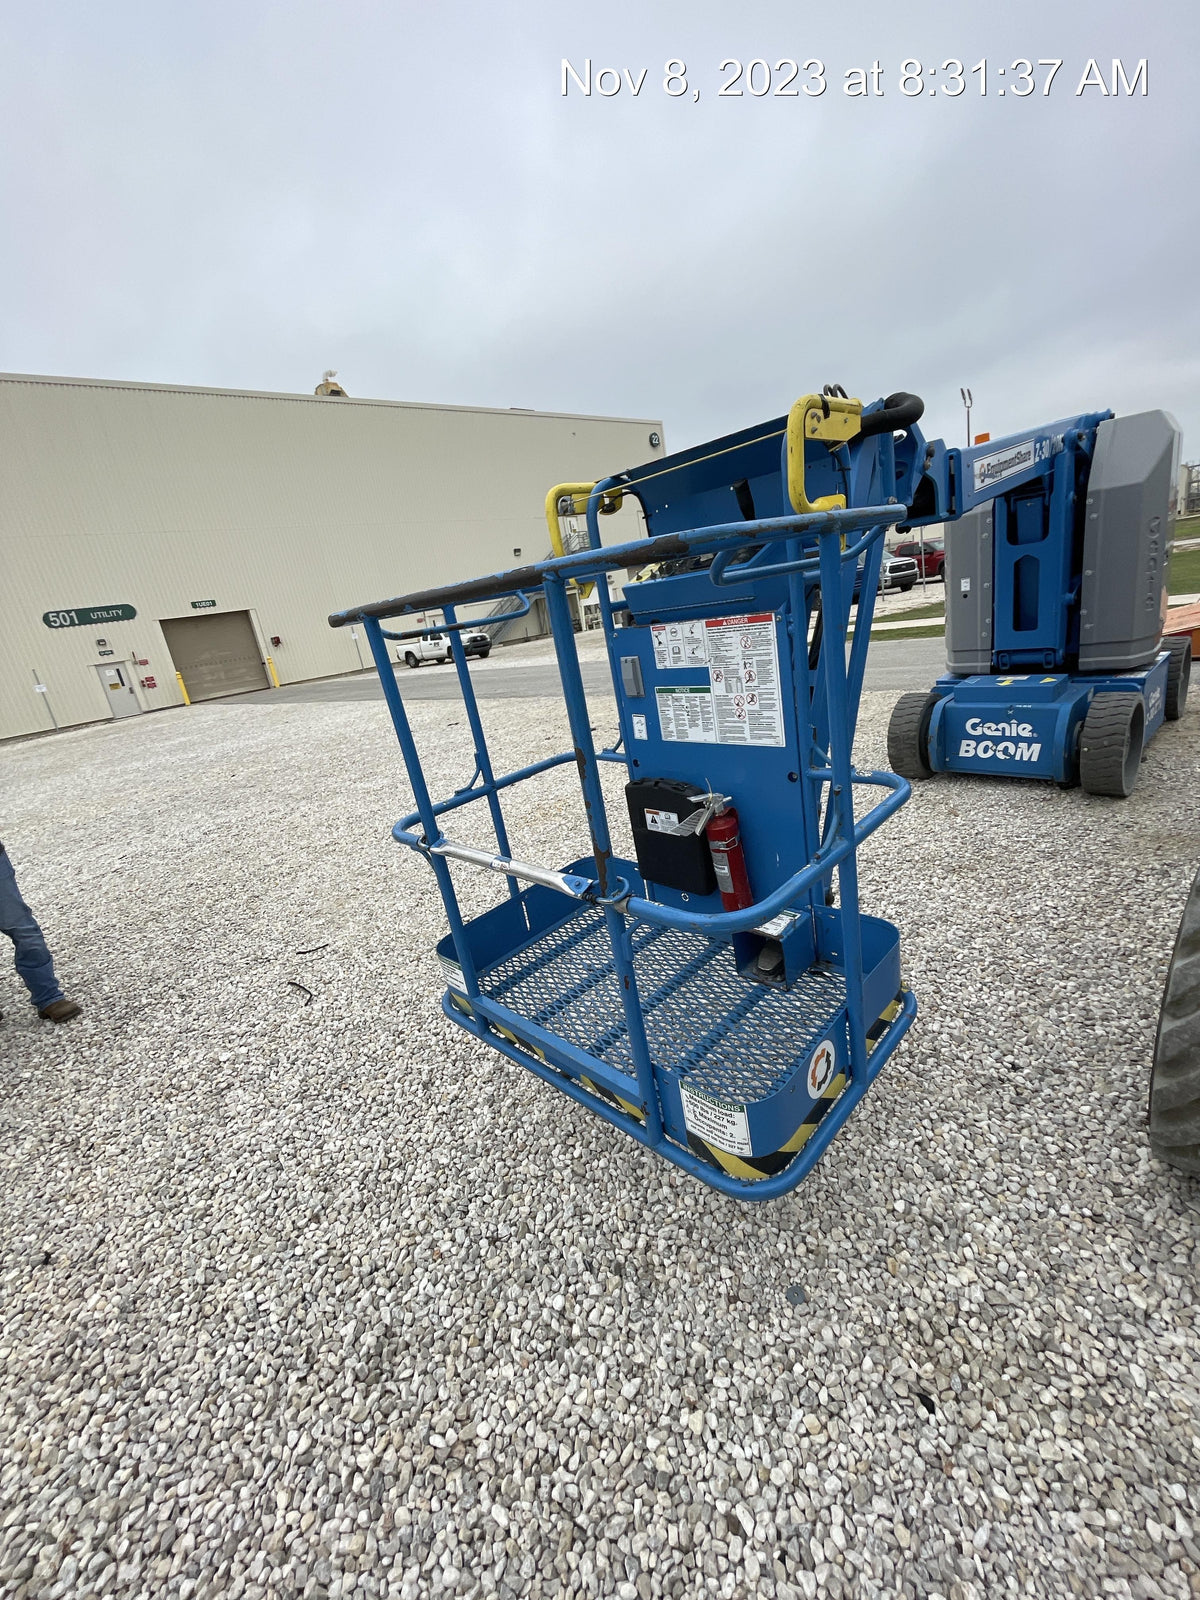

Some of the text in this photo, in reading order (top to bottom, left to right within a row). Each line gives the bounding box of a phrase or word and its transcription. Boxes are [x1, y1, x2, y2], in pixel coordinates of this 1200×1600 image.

[986, 450, 1032, 477] EquipmentShare
[48, 609, 124, 627] 501 UTILITY
[726, 617, 749, 626] DANGER
[965, 717, 1034, 738] Genie
[958, 739, 1042, 762] BOOM
[682, 1083, 741, 1111] INSTRUCTIONS
[688, 1094, 736, 1119] Maximum load:
[698, 1111, 729, 1130] Maximum
[713, 1113, 725, 1122] 227
